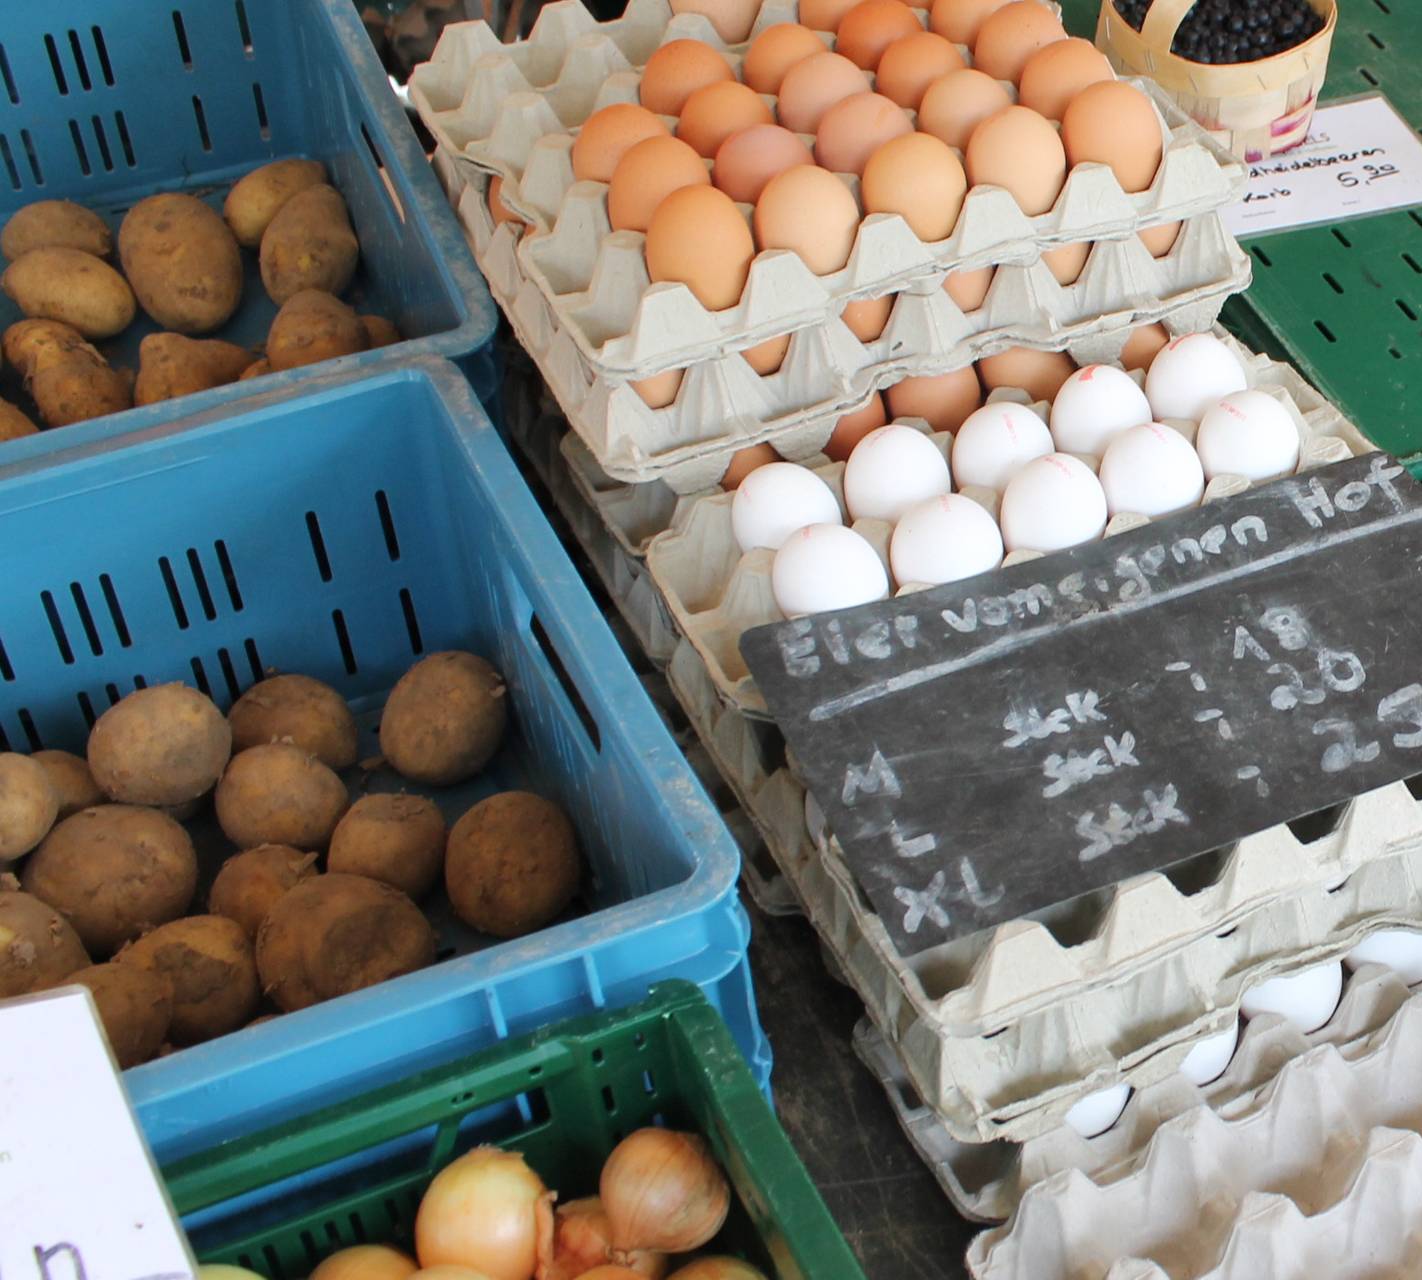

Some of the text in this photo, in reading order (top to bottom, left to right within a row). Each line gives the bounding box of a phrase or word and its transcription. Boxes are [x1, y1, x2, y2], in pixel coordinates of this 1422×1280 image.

[777, 614, 918, 678] Eier
[1294, 454, 1405, 528] Hof
[842, 747, 902, 806] M
[890, 819, 937, 858] L
[1267, 647, 1367, 711] 20
[893, 856, 1006, 934] XL
